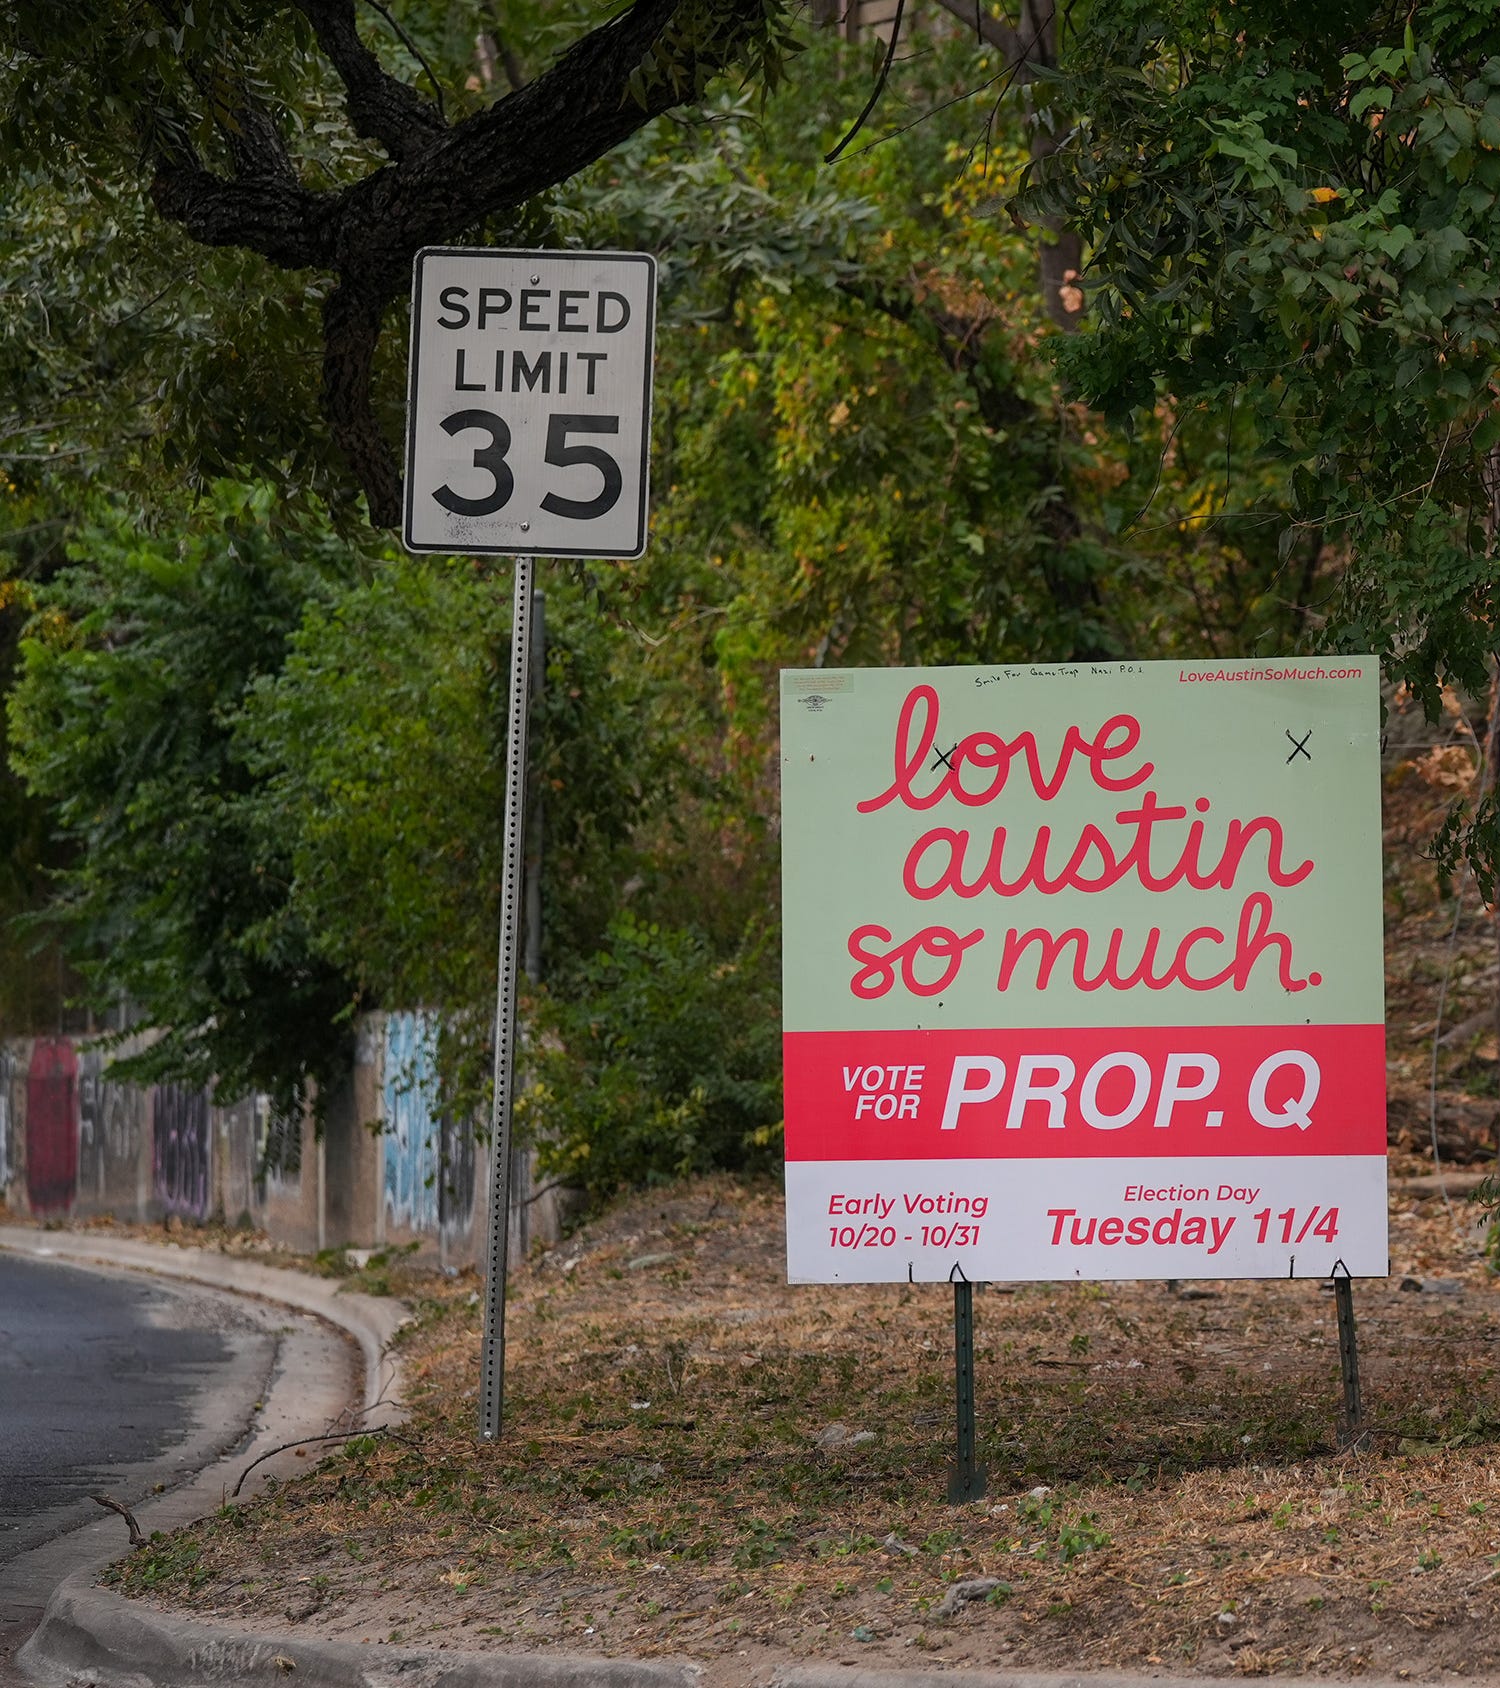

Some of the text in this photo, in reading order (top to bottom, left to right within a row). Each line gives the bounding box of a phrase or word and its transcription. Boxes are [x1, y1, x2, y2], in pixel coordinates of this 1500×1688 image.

[437, 287, 630, 333] SPEED
[455, 349, 607, 395] LIMIT
[432, 409, 622, 520] 35
[1179, 667, 1362, 683] LoveAustinSoMuch.com
[857, 685, 1154, 813] love
[903, 791, 1315, 900] austin
[848, 891, 1323, 1000] so much.
[843, 1066, 926, 1094] VOTE
[941, 1050, 1321, 1131] PROP. Q
[855, 1093, 921, 1120] FOR
[829, 1192, 988, 1219] Early Voting
[1124, 1184, 1260, 1204] Election Day
[830, 1223, 896, 1249] 10/20
[922, 1222, 980, 1248] 10/31
[1047, 1206, 1339, 1254] Tuesday 11/4
